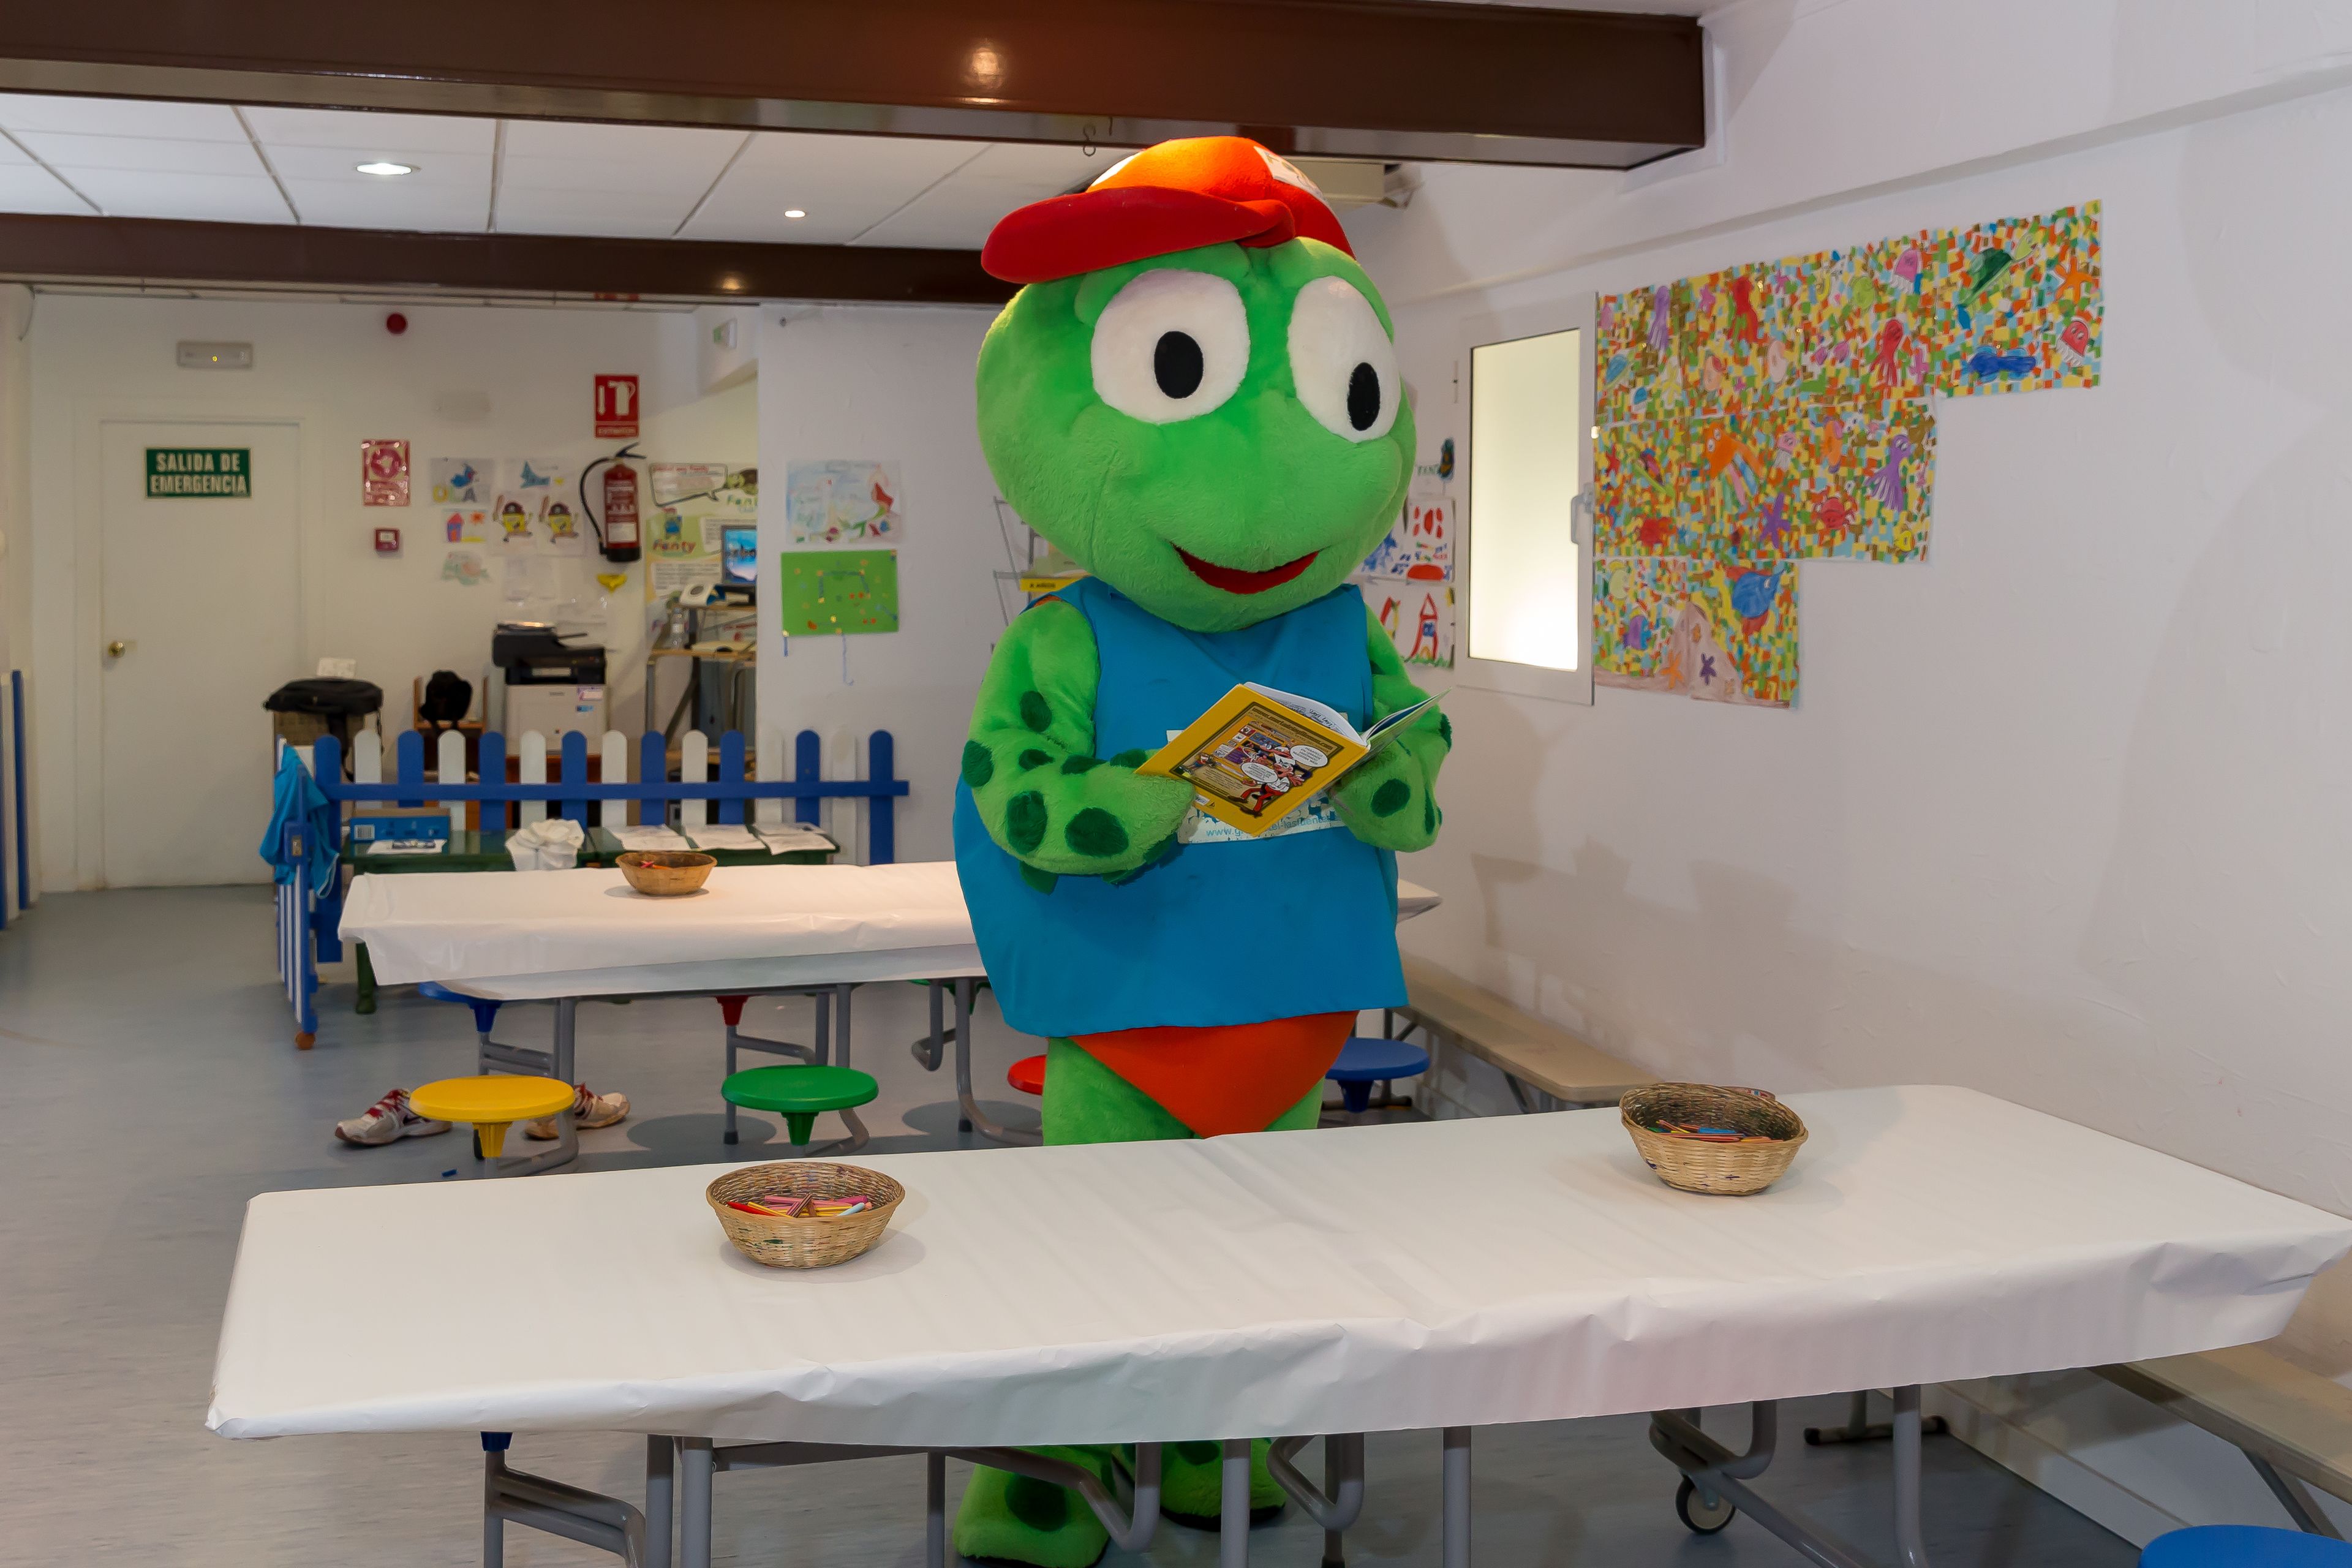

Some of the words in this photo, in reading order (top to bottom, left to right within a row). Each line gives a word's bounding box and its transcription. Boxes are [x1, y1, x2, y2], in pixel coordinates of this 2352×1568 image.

[156, 453, 214, 472] SALIDA
[220, 453, 241, 472] DE
[151, 474, 247, 493] EMERGENCIA
